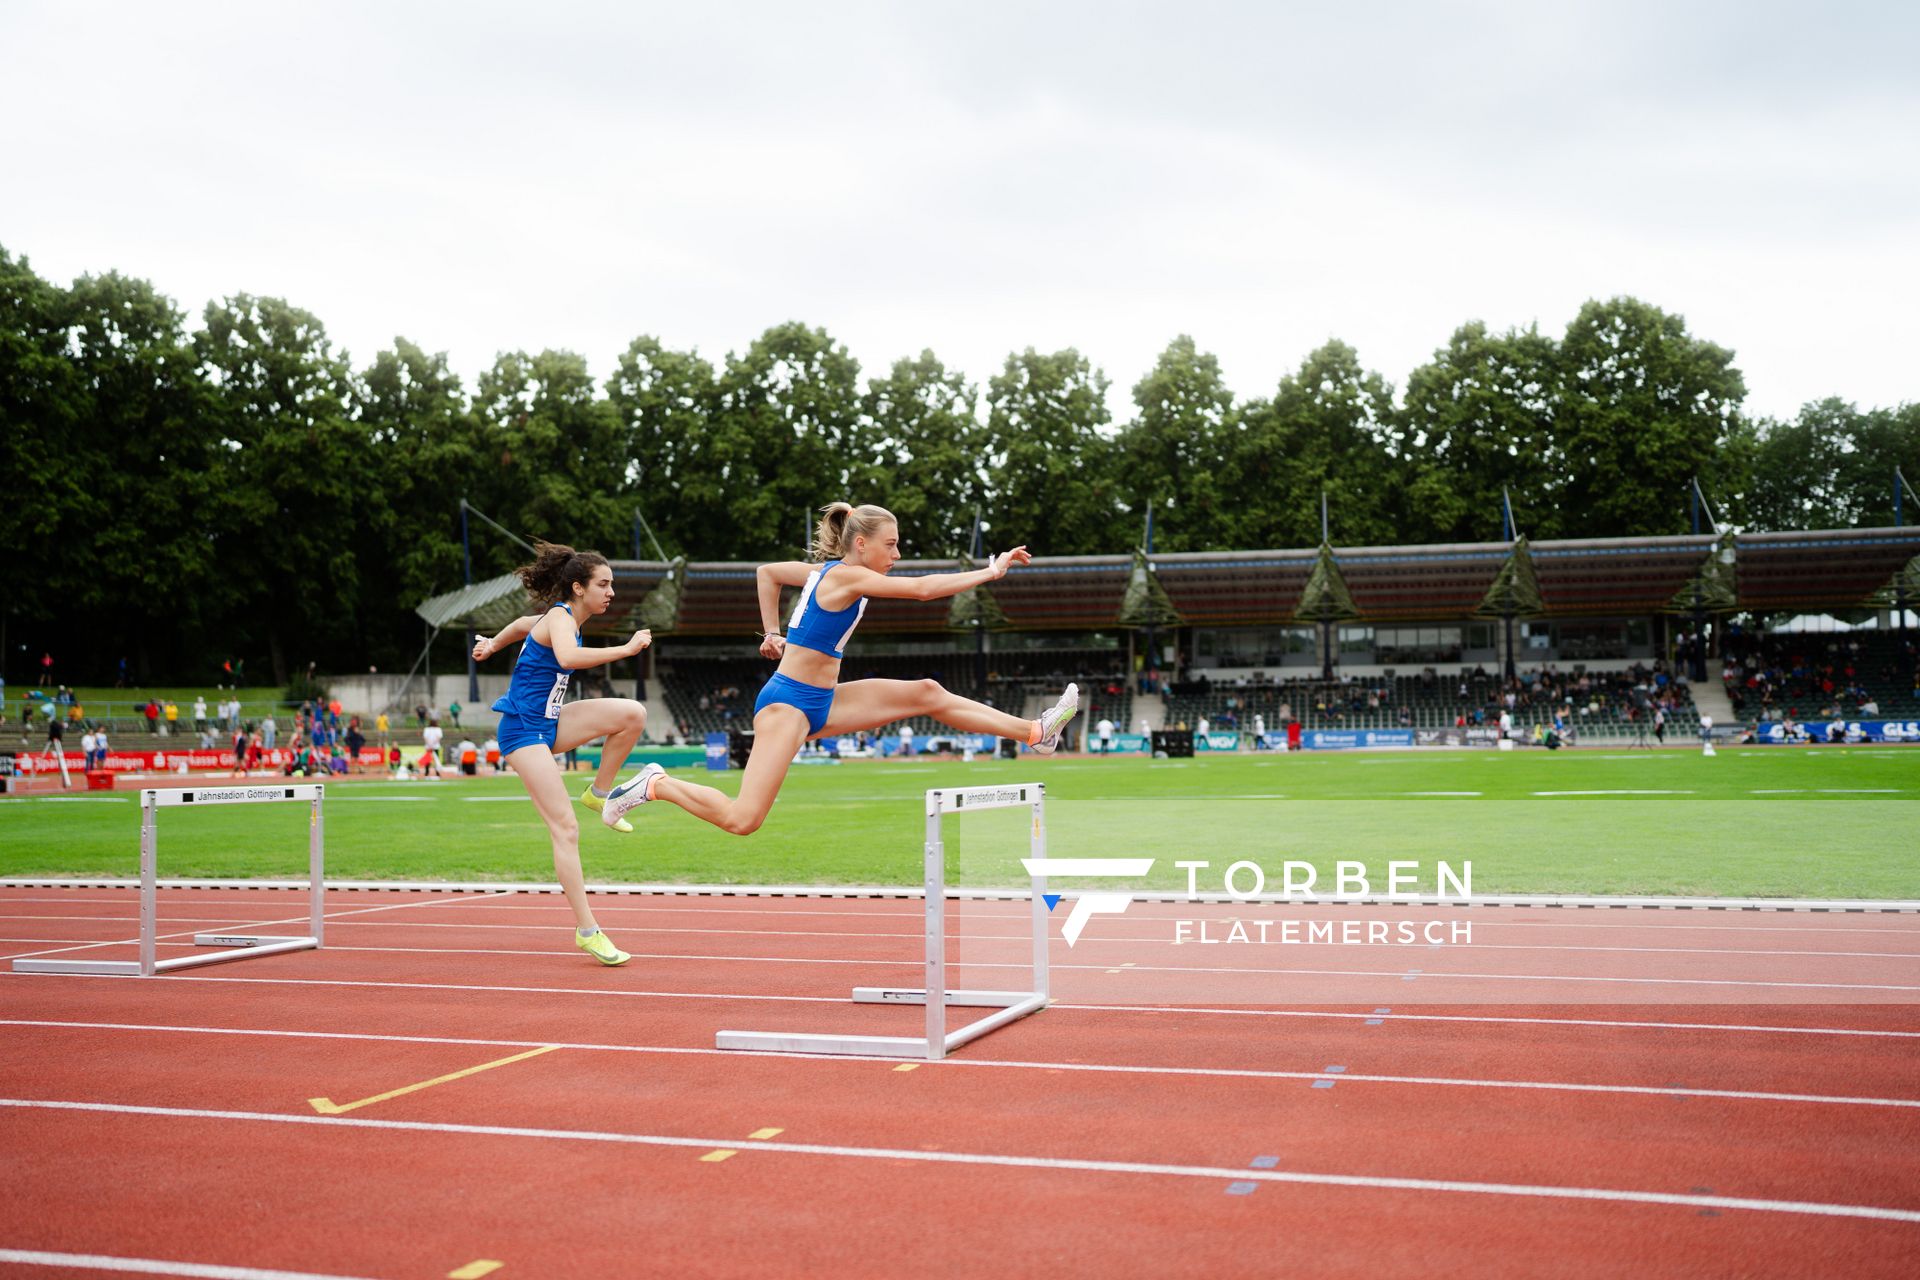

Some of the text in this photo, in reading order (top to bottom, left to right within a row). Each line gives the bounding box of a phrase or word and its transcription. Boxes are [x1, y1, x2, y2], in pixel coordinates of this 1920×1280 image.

[1769, 724, 1805, 737] GS
[198, 788, 282, 801] Jahnstadion Göttingen
